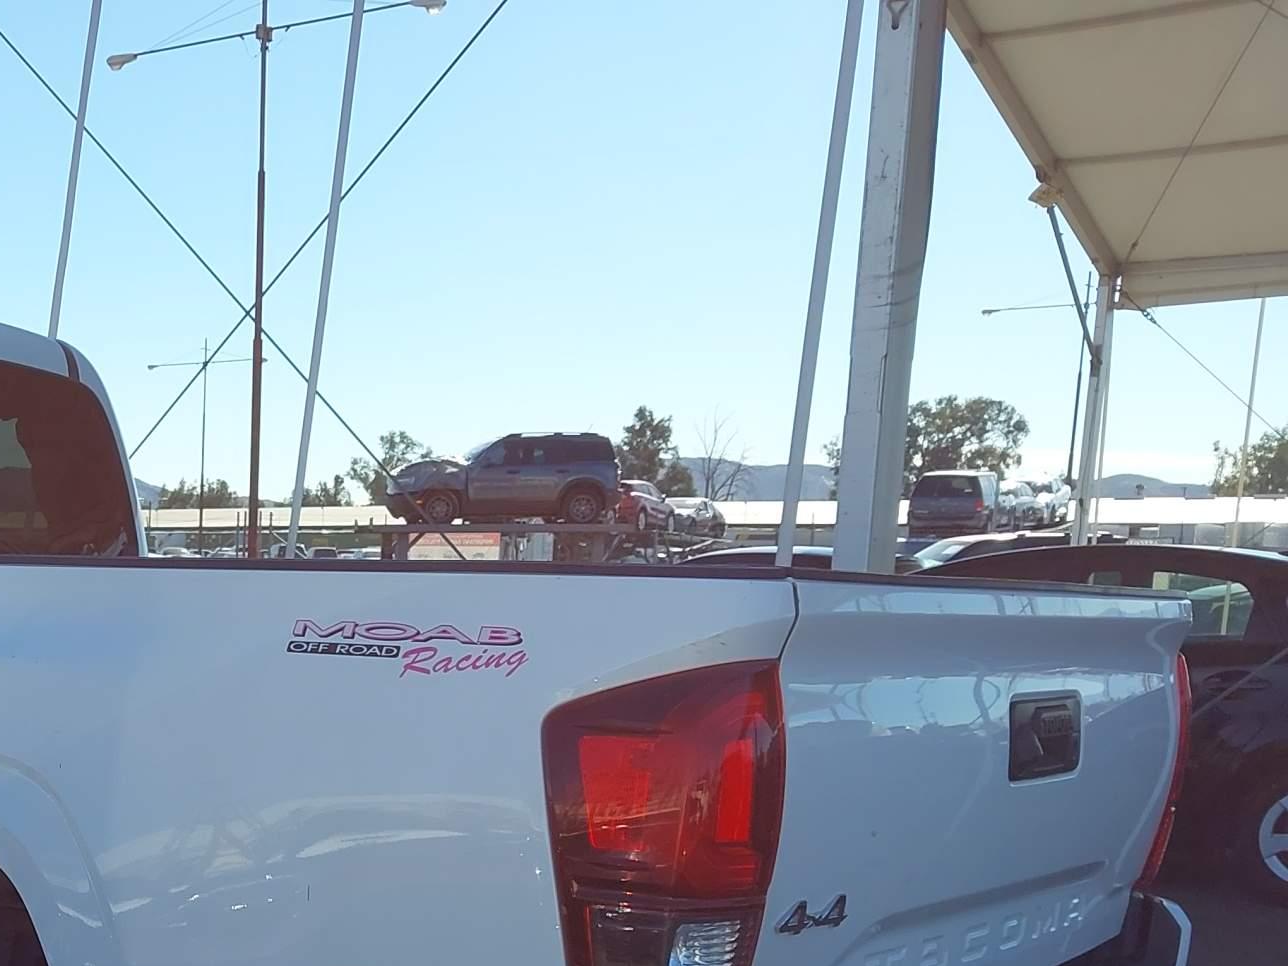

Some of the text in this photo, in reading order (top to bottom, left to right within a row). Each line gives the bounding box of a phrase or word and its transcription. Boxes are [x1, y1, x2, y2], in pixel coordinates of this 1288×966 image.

[292, 619, 523, 646] MOAB
[289, 642, 398, 657] OFF ROAD
[399, 646, 529, 678] Racing
